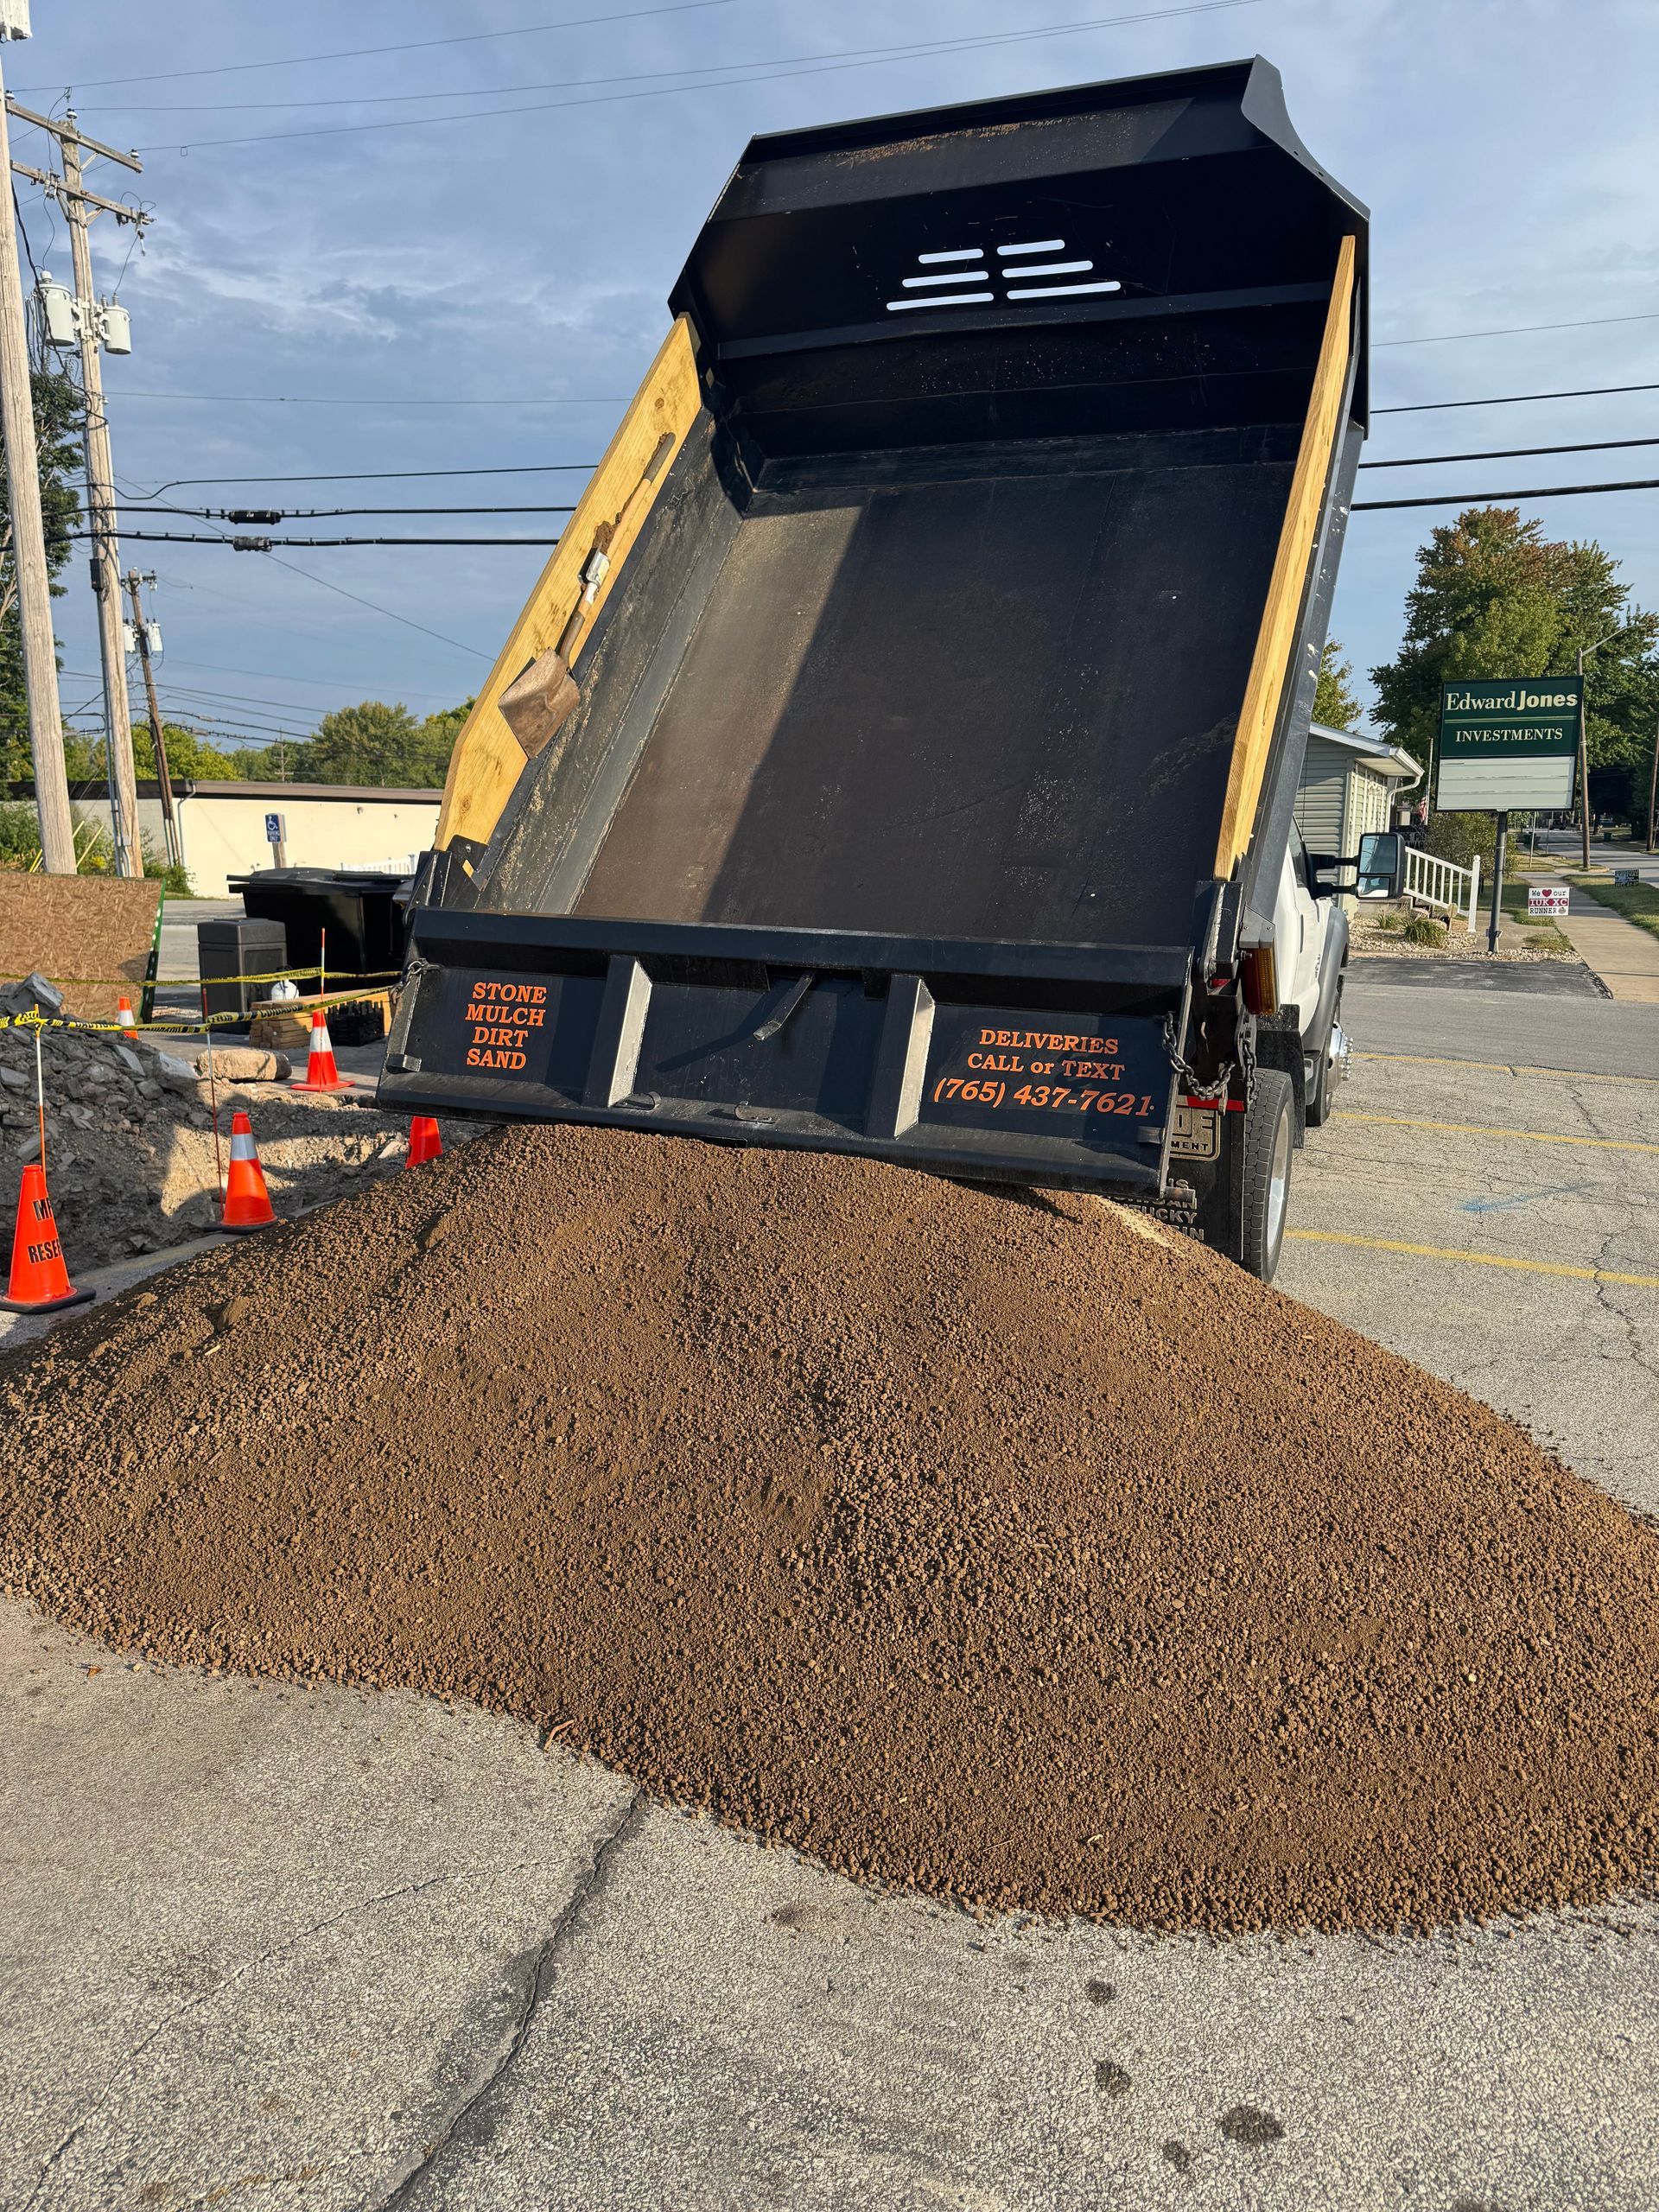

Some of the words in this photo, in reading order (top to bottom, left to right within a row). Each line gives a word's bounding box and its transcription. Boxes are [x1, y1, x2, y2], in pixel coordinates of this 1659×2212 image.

[1446, 690, 1516, 710] Edward
[1516, 690, 1578, 711] Jones
[1455, 728, 1563, 742] INVESTMENTS
[472, 982, 547, 1004] STONE
[465, 1004, 546, 1027] MULCH
[472, 1027, 528, 1047] DIRT
[979, 1029, 1119, 1055] DELIVERIES
[467, 1048, 526, 1070] SAND
[968, 1052, 1024, 1072] CALL
[1030, 1060, 1055, 1075] or
[1061, 1059, 1125, 1080] TEXT
[933, 1077, 1006, 1109] (765)
[1013, 1084, 1152, 1116] 437-7621
[1170, 1140, 1209, 1151] MENT
